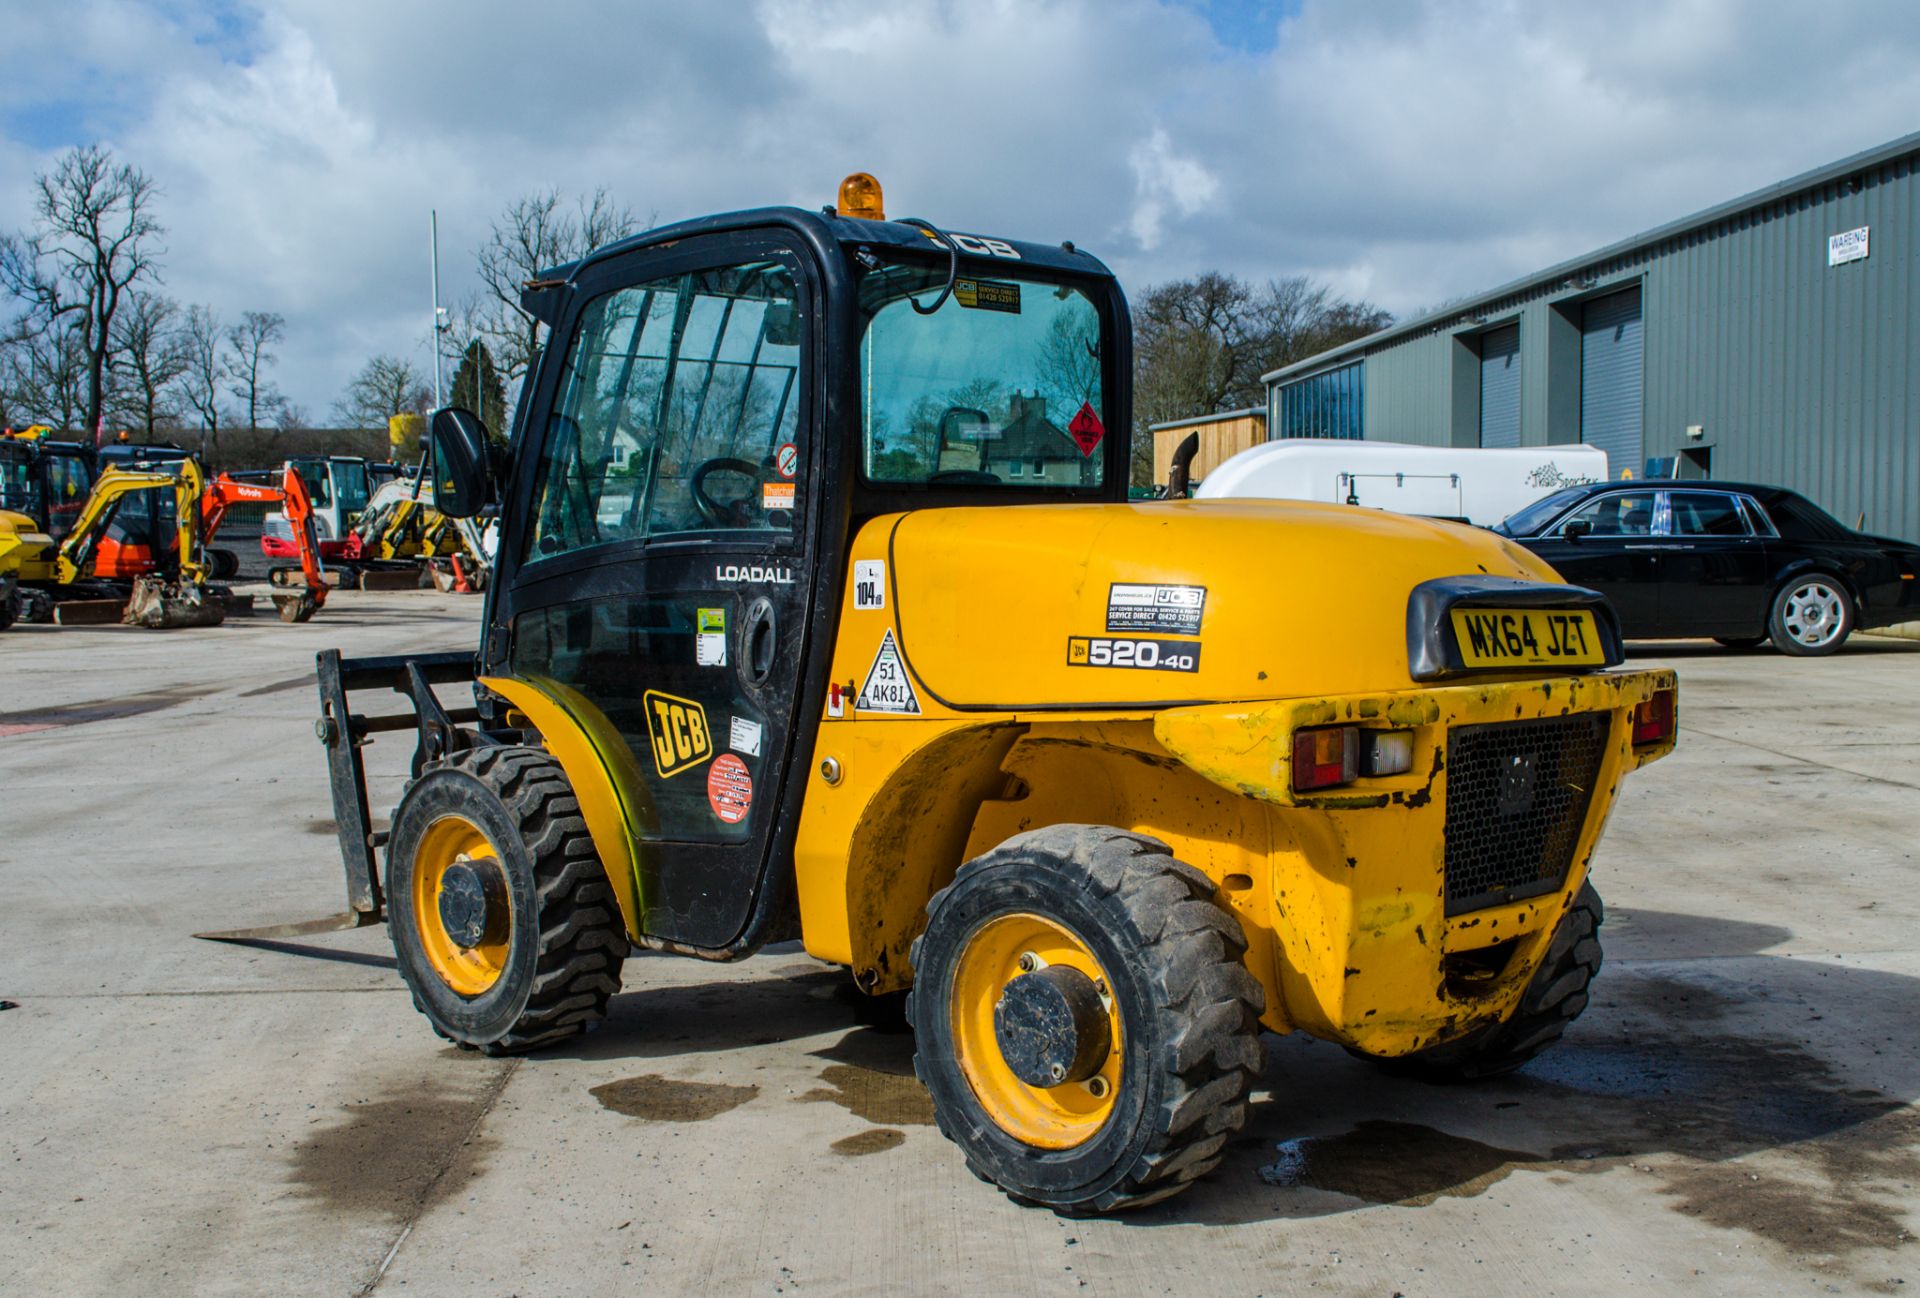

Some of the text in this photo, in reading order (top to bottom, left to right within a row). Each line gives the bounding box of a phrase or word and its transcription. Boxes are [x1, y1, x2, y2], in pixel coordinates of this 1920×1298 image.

[716, 566, 795, 584] LOADALL
[857, 582, 874, 605] 104
[1133, 612, 1155, 620] DIRECT
[1178, 614, 1200, 622] 525917
[1464, 615, 1588, 658] MX64 JZT
[880, 662, 895, 680] 51
[654, 700, 706, 768] JCB
